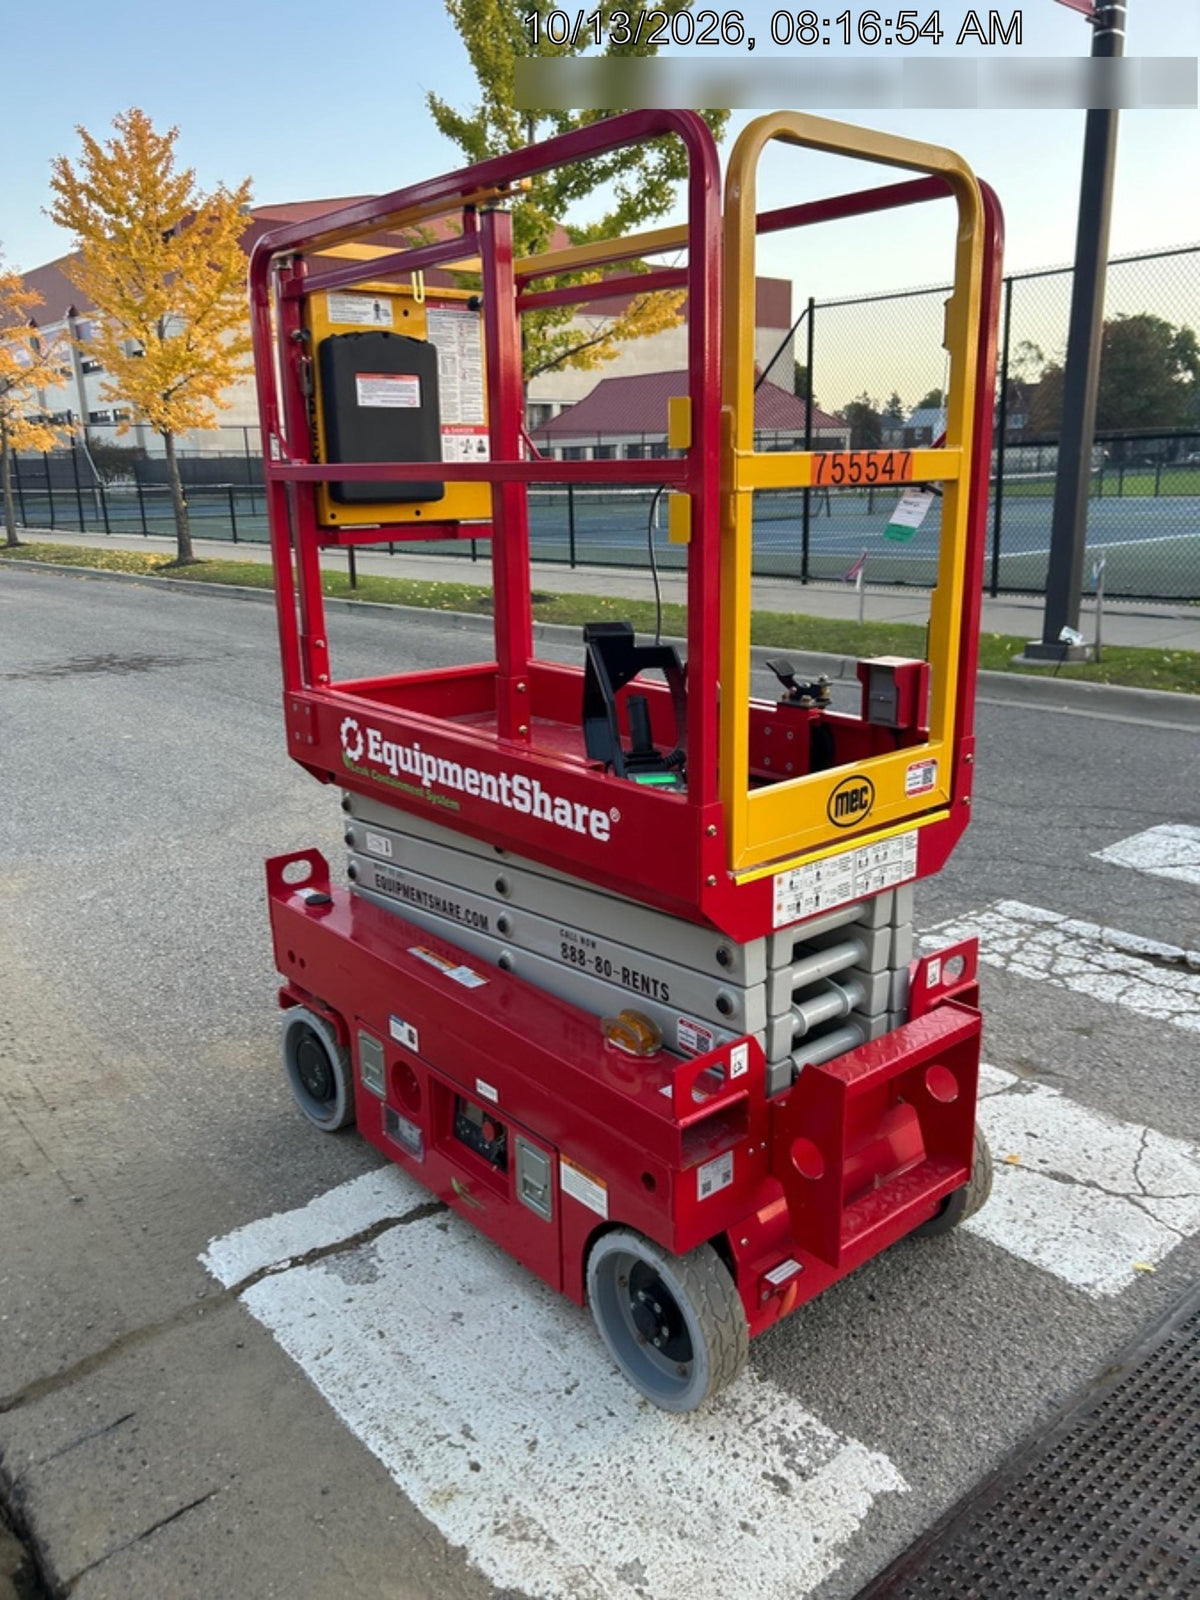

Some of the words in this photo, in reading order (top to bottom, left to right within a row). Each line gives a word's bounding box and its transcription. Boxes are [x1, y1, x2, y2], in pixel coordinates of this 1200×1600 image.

[814, 451, 911, 485] 755547
[374, 873, 490, 932] EQUIPMENTSHARE.COM
[560, 942, 670, 1002] 888-80-RENTS
